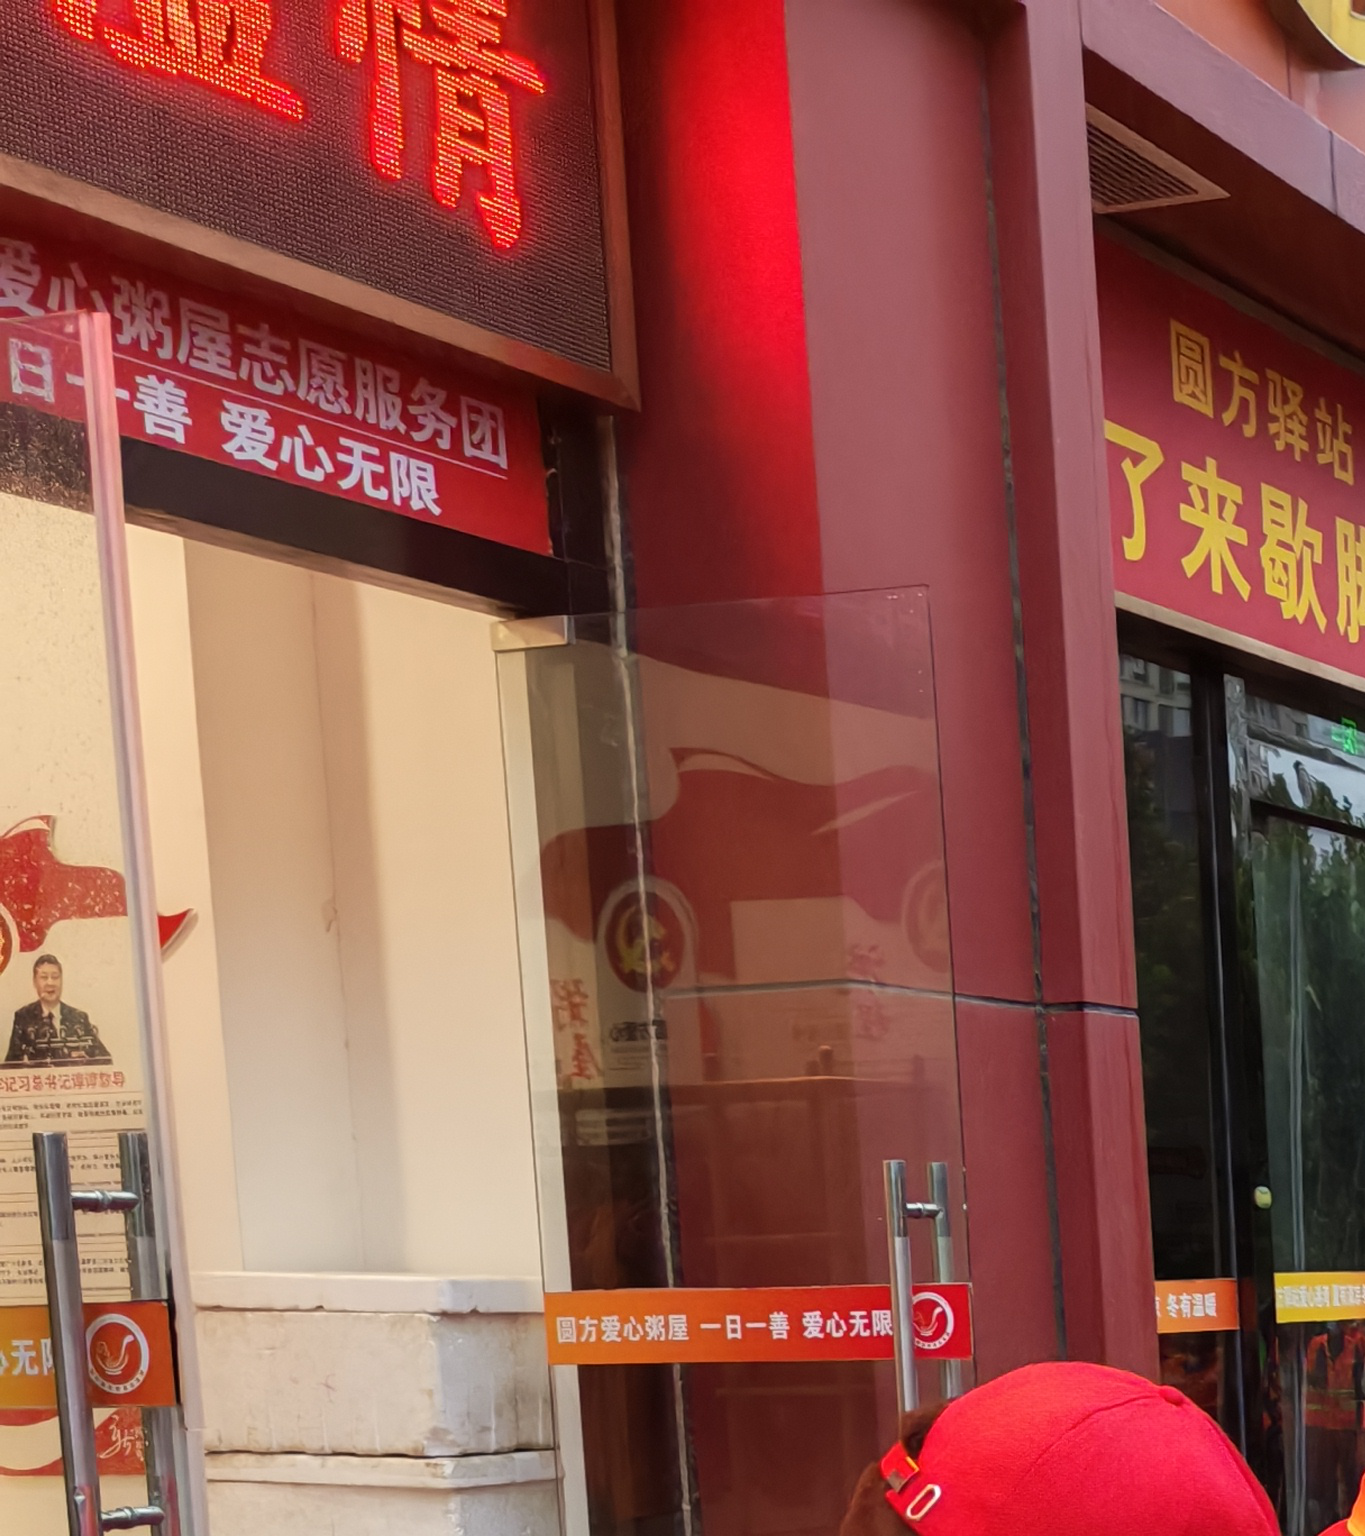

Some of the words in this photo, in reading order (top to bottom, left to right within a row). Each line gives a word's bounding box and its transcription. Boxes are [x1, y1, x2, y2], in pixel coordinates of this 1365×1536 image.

[220, 399, 442, 516] 爱心无限
[1169, 319, 1356, 486] 圆方驿站
[556, 1313, 690, 1344] 圆方爱心粥屋
[700, 1311, 791, 1341] 一日一善
[802, 1308, 895, 1340] 爱心无限
